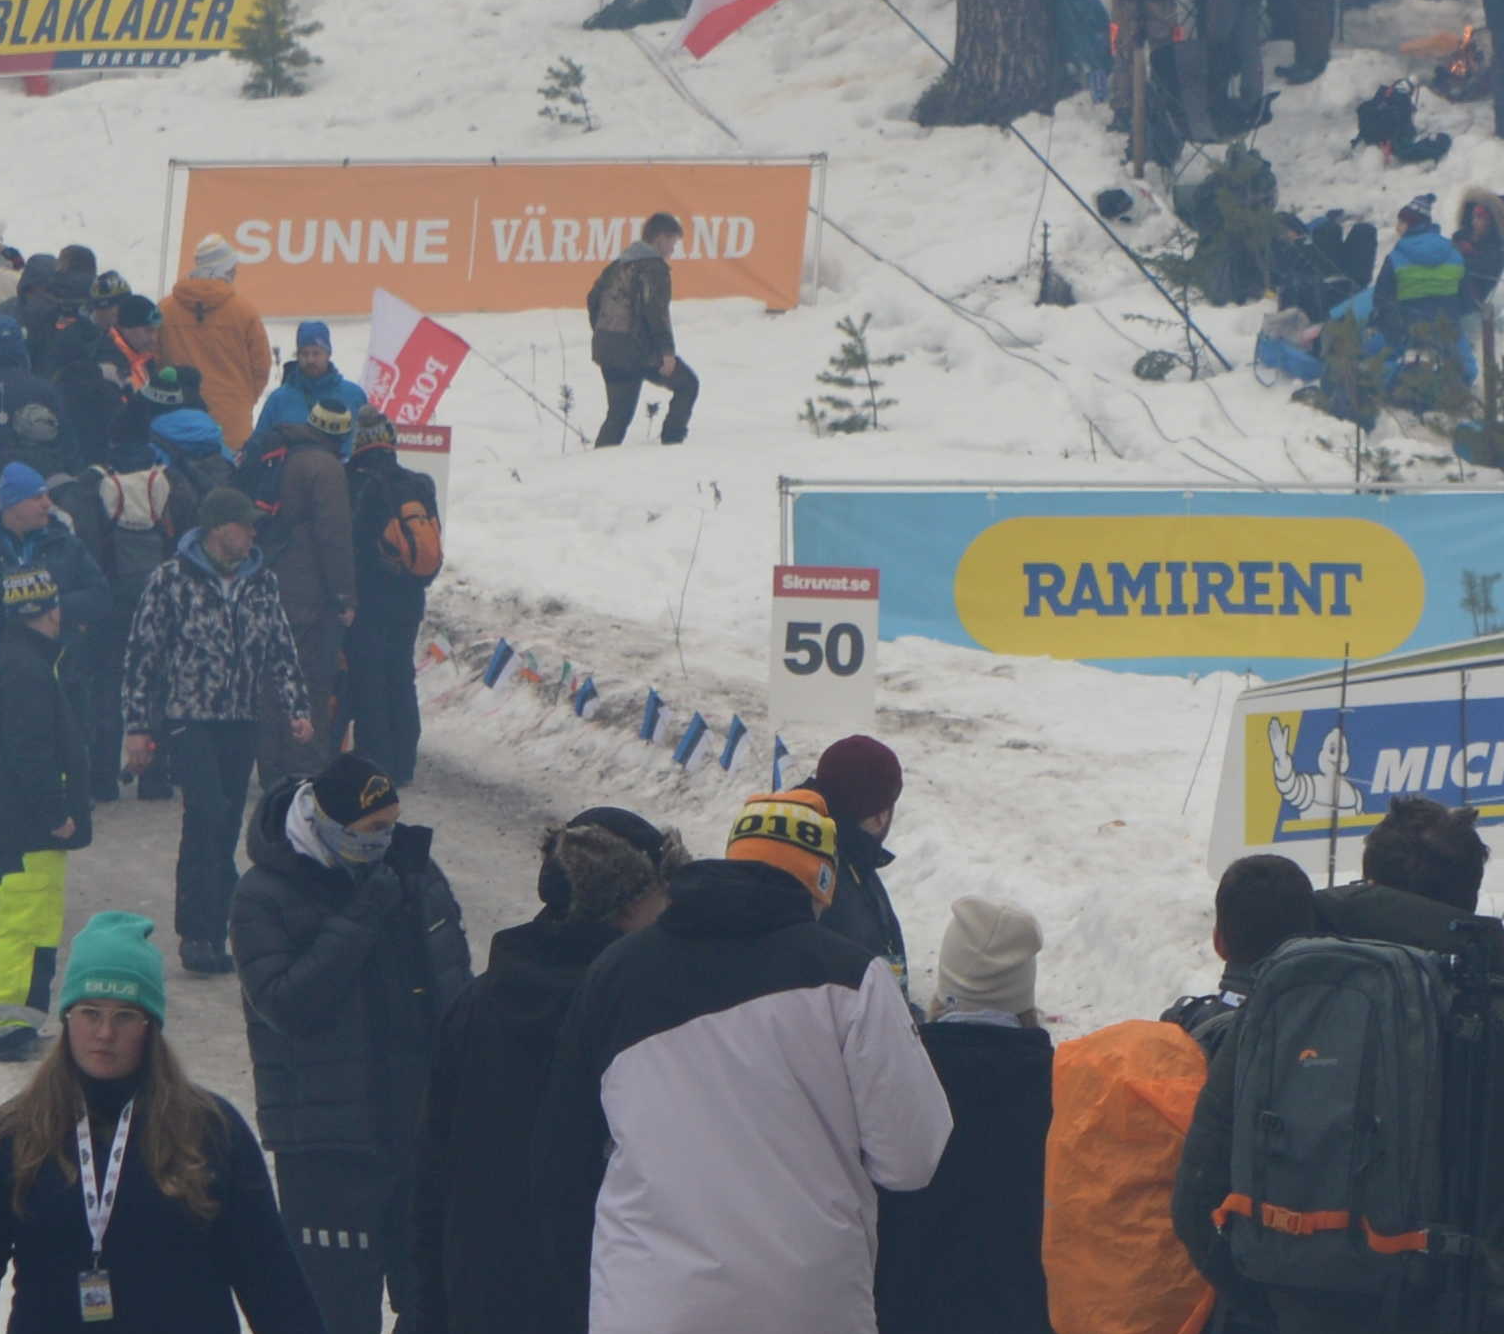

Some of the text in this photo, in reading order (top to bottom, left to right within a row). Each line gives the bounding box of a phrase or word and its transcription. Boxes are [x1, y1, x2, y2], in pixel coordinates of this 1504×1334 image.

[234, 218, 450, 265] SUNNE
[782, 574, 871, 592] Skruvat.se
[1022, 560, 1363, 619] RAMIRENT
[782, 621, 866, 677] 50
[734, 814, 823, 848] 018
